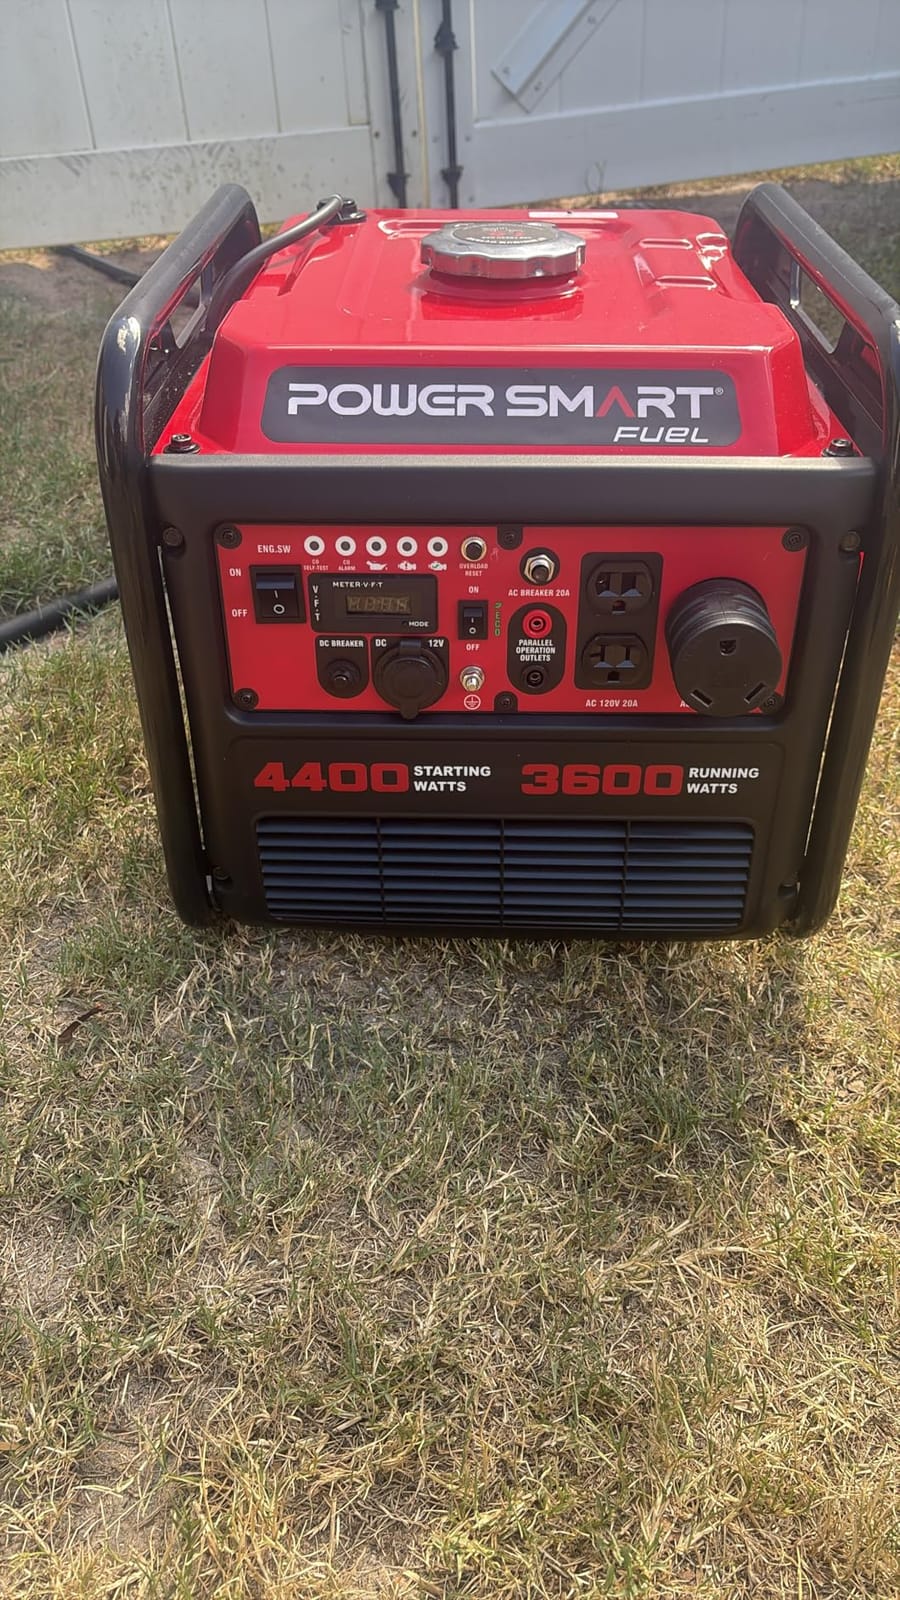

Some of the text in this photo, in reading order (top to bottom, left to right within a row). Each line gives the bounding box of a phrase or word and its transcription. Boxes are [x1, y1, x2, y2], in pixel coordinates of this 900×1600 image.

[288, 383, 494, 417] POWER
[257, 544, 291, 553] ENG.SW
[229, 568, 242, 577] ON
[468, 586, 479, 594] ON
[508, 589, 570, 597] AC BREAKER 20A
[231, 608, 248, 617] OFF
[319, 639, 364, 647] DC BREAKER
[375, 639, 445, 647] DC 12V
[515, 646, 556, 654] OPERATION
[585, 699, 638, 707] AC 120V 20A
[413, 765, 491, 777] STARTING
[688, 767, 760, 779] RUNNING
[253, 762, 410, 793] 4400
[521, 763, 684, 796] 3600
[413, 780, 467, 792] WATTS
[686, 782, 738, 794] WATTS
